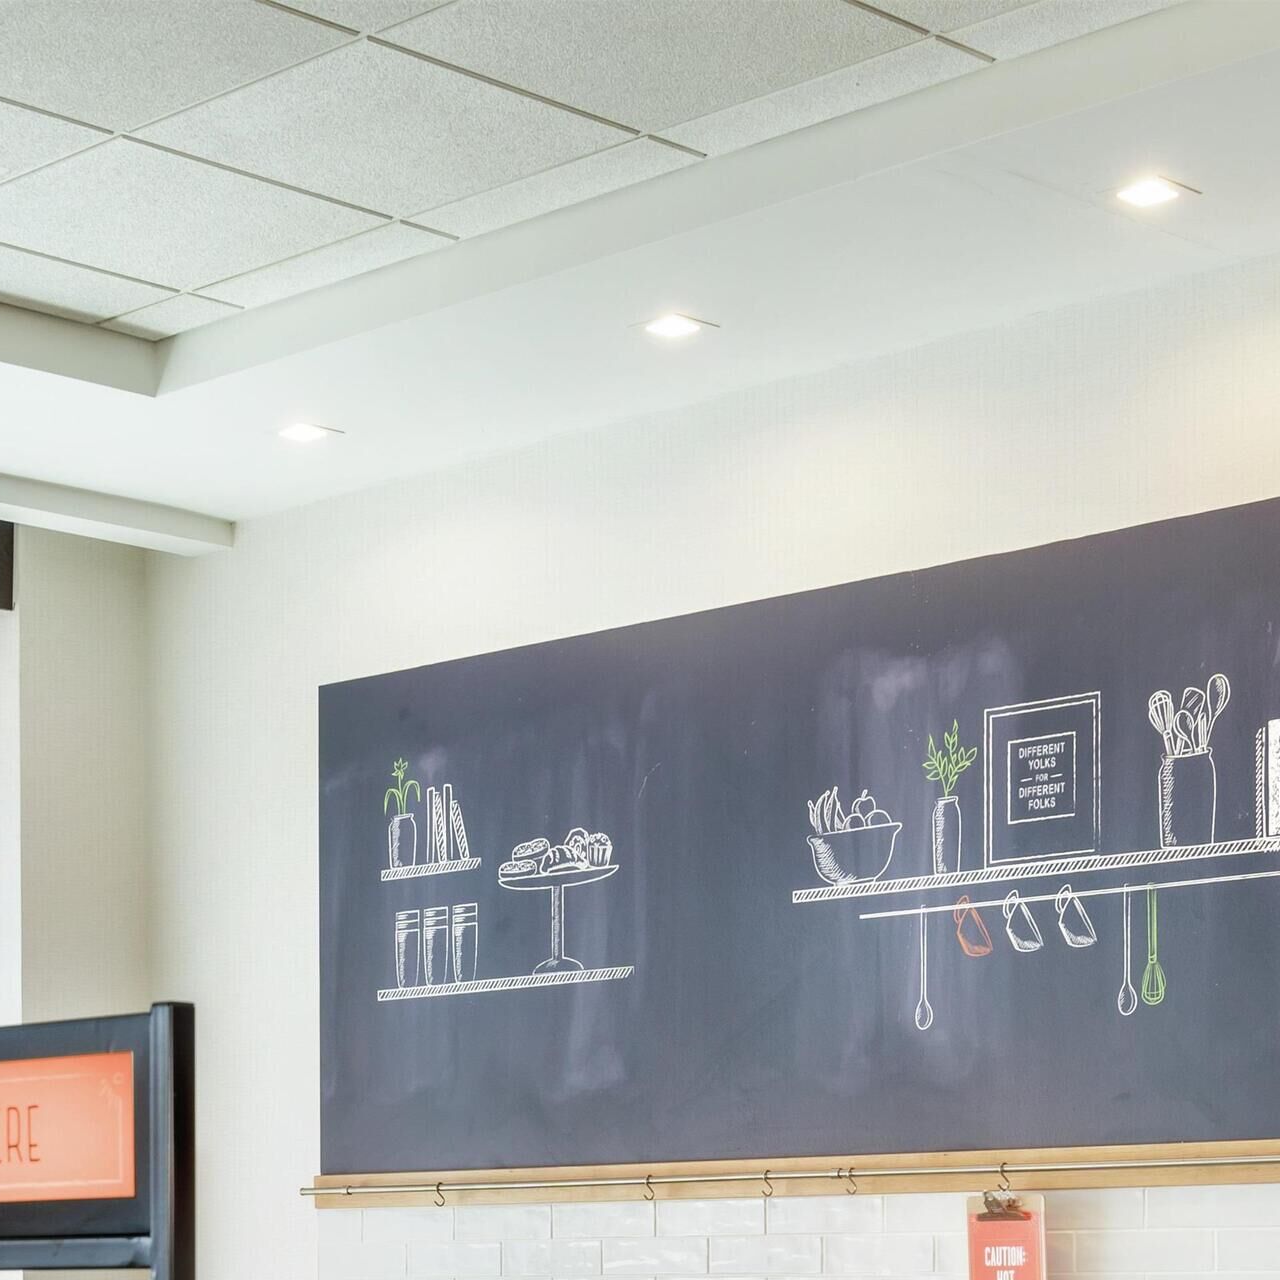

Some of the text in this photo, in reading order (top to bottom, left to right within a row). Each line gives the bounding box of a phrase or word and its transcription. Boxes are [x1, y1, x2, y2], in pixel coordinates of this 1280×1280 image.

[1018, 742, 1066, 759] DIFFERENT
[1028, 757, 1057, 770] YOLKS
[1035, 773, 1049, 783] FOR
[1018, 782, 1066, 799] DIFFERENT
[1028, 797, 1056, 811] FOLKS
[984, 1246, 1027, 1266] CAUTION:
